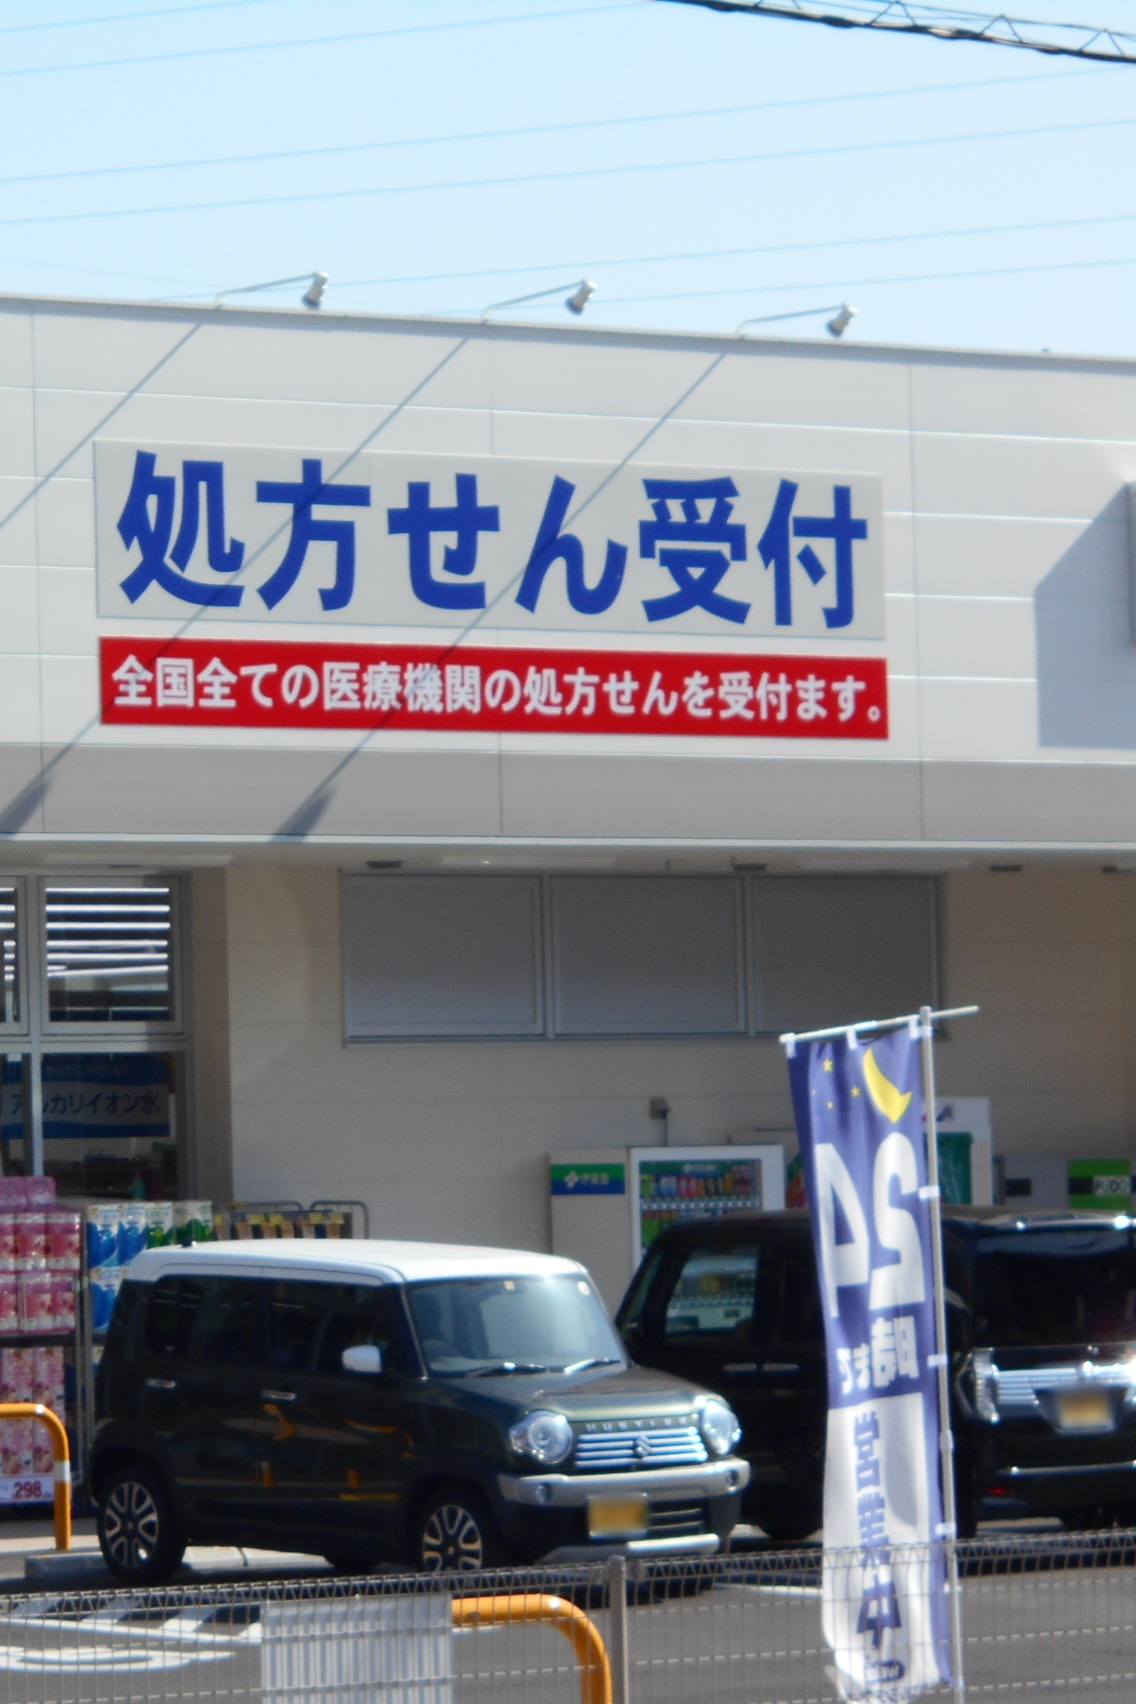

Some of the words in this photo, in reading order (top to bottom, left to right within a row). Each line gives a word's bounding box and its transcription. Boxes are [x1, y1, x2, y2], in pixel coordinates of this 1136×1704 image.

[117, 450, 869, 630] 処方せん受付
[111, 653, 881, 723] 全国全ての医療機関の処方せんを受付ます。
[11, 1091, 160, 1115] アカリイオン水
